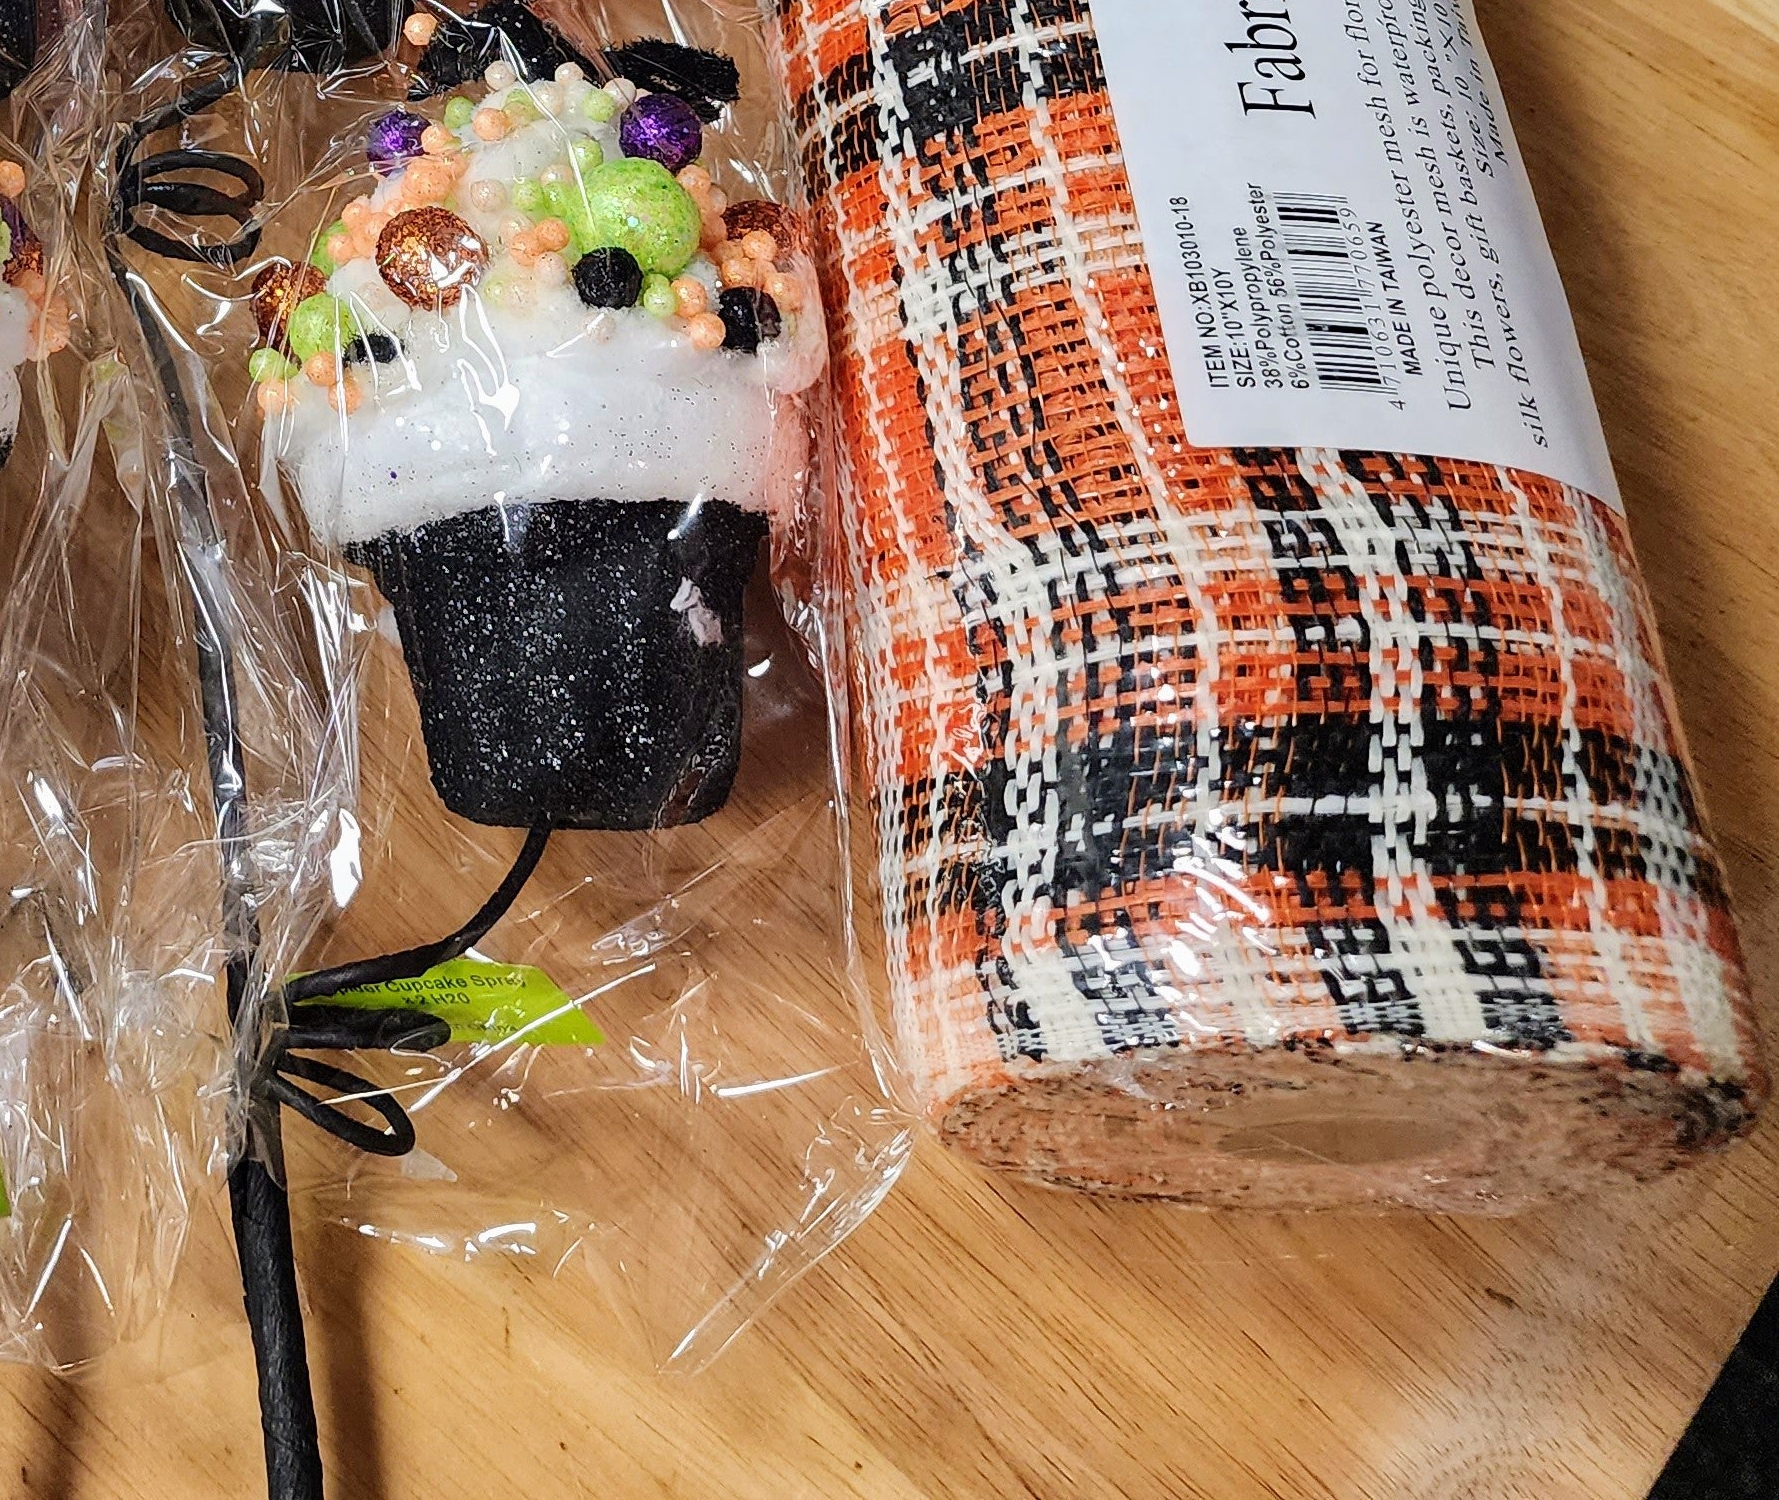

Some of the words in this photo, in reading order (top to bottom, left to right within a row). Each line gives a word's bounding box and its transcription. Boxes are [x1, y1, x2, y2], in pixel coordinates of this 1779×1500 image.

[1357, 50, 1383, 88] for
[1469, 58, 1483, 85] in
[1365, 96, 1405, 164] mesh
[1407, 116, 1430, 138] is
[1438, 103, 1478, 206] baskets,
[1465, 110, 1495, 179] Size:
[1479, 90, 1509, 166] Made
[1416, 148, 1453, 216] mesh
[1169, 196, 1219, 338] NO:XB103010-18
[1246, 182, 1287, 298] 56%Polyester
[1365, 221, 1400, 292] TAIWAN
[1388, 170, 1448, 300] polyester
[1441, 222, 1475, 299] decor
[1465, 212, 1499, 264] gift
[1232, 227, 1283, 388] 38%Polypropylene
[1386, 299, 1407, 316] IN
[1462, 310, 1496, 370] This
[1487, 272, 1530, 386] flowers,
[1201, 344, 1229, 388] ITEM
[1275, 304, 1309, 389] 6%Cotton
[1393, 322, 1423, 376] MADE
[1429, 306, 1472, 410] Unique
[1517, 393, 1549, 449] silk
[385, 975, 468, 993] Cupcake
